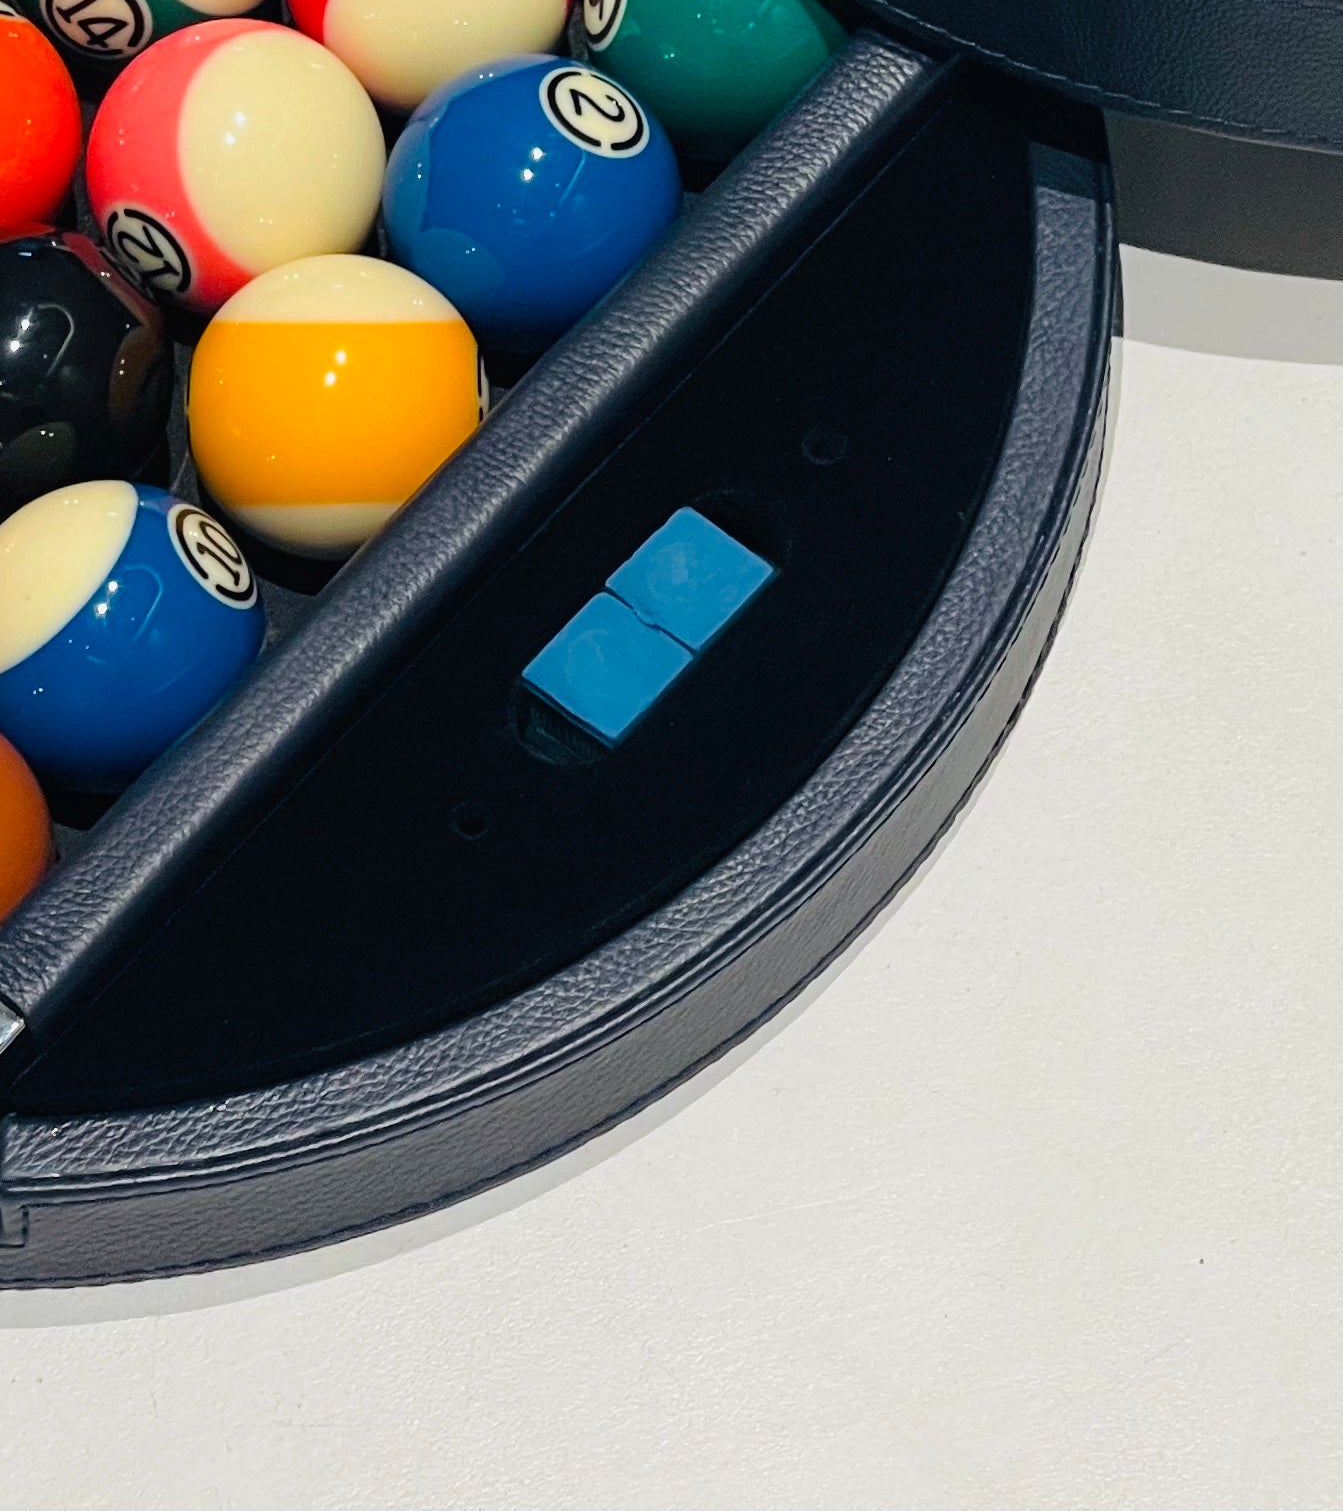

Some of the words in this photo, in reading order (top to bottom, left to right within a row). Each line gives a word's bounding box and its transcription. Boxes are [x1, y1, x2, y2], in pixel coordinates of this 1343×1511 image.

[569, 89, 626, 123] 2
[117, 225, 180, 279] 12
[197, 520, 243, 586] 10
